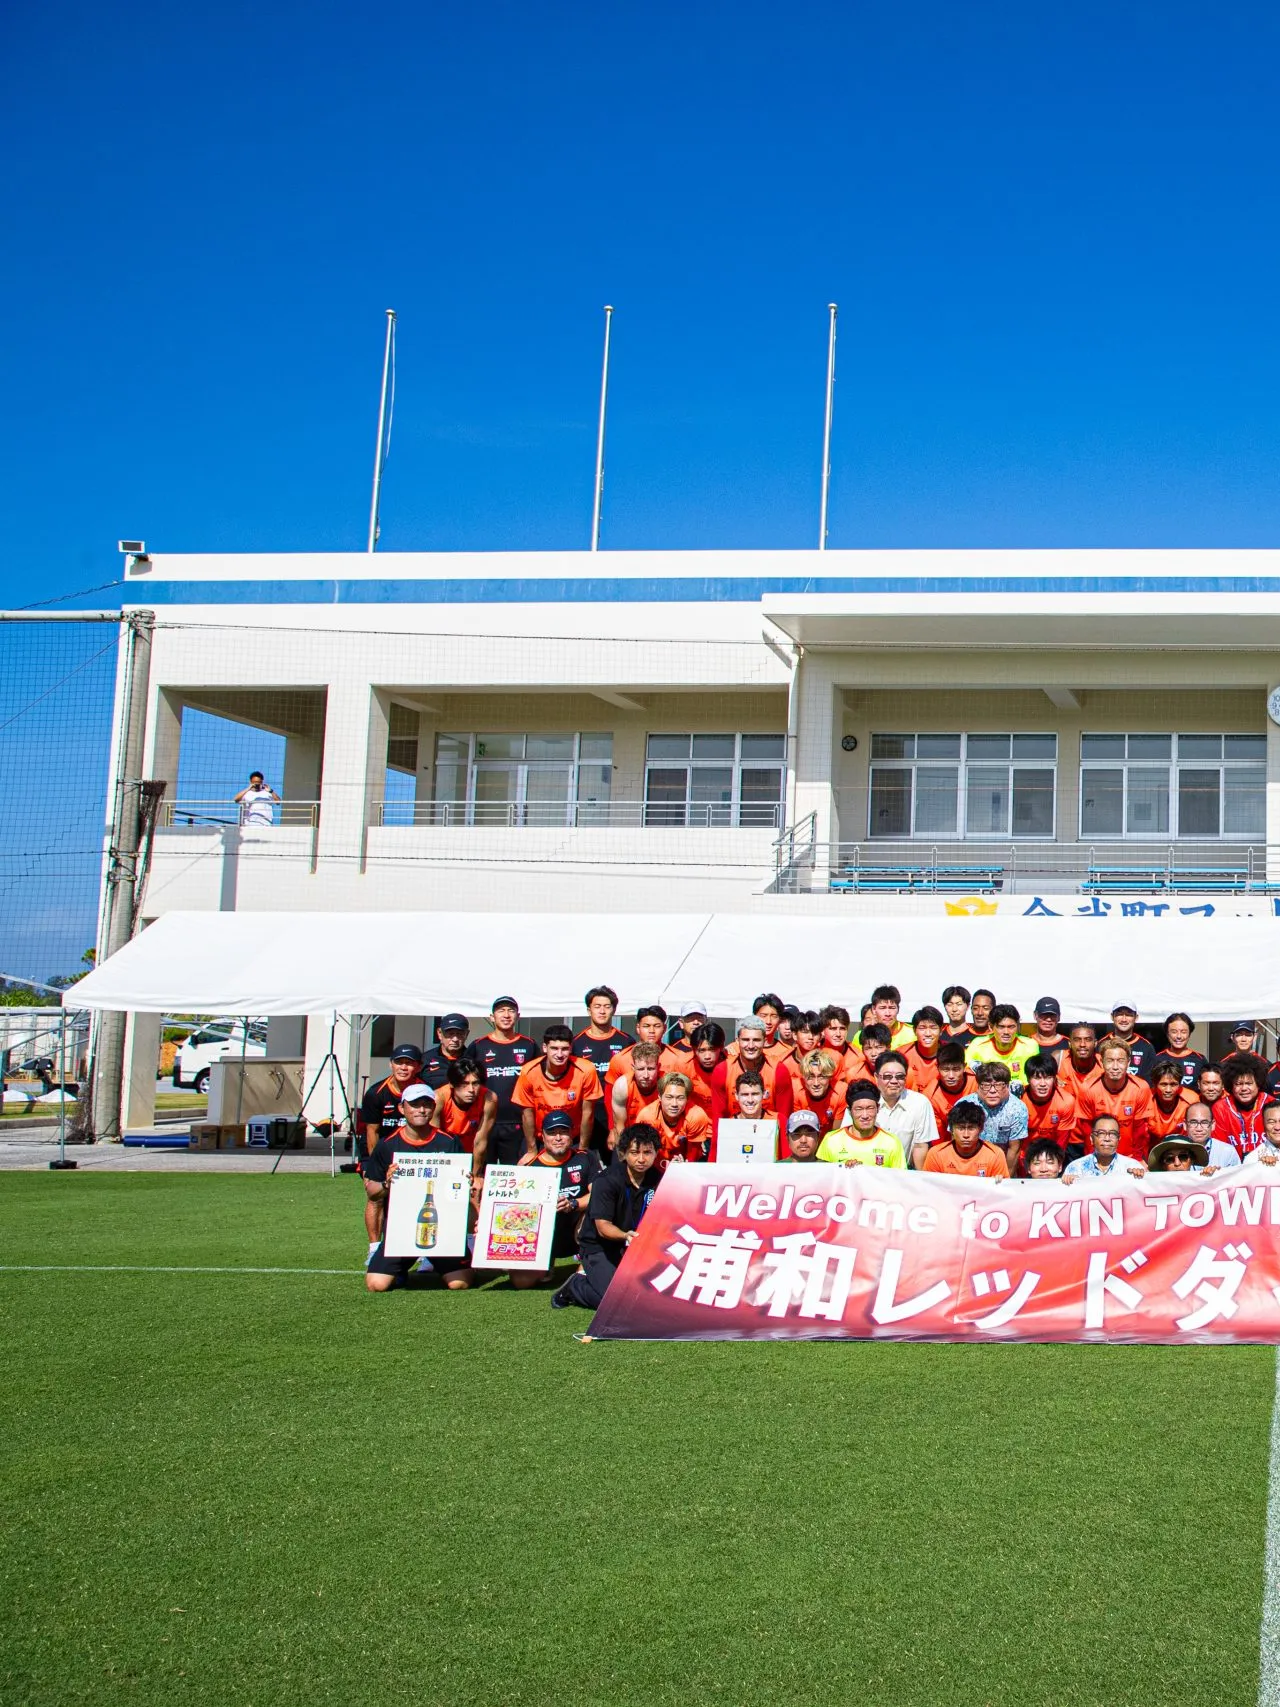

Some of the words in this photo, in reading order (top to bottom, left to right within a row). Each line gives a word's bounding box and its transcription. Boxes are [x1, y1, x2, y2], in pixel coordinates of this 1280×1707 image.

[490, 1178, 536, 1189] タコライス
[703, 1184, 938, 1234] Welcome
[960, 1200, 1010, 1240] to
[1028, 1197, 1125, 1240] KIN
